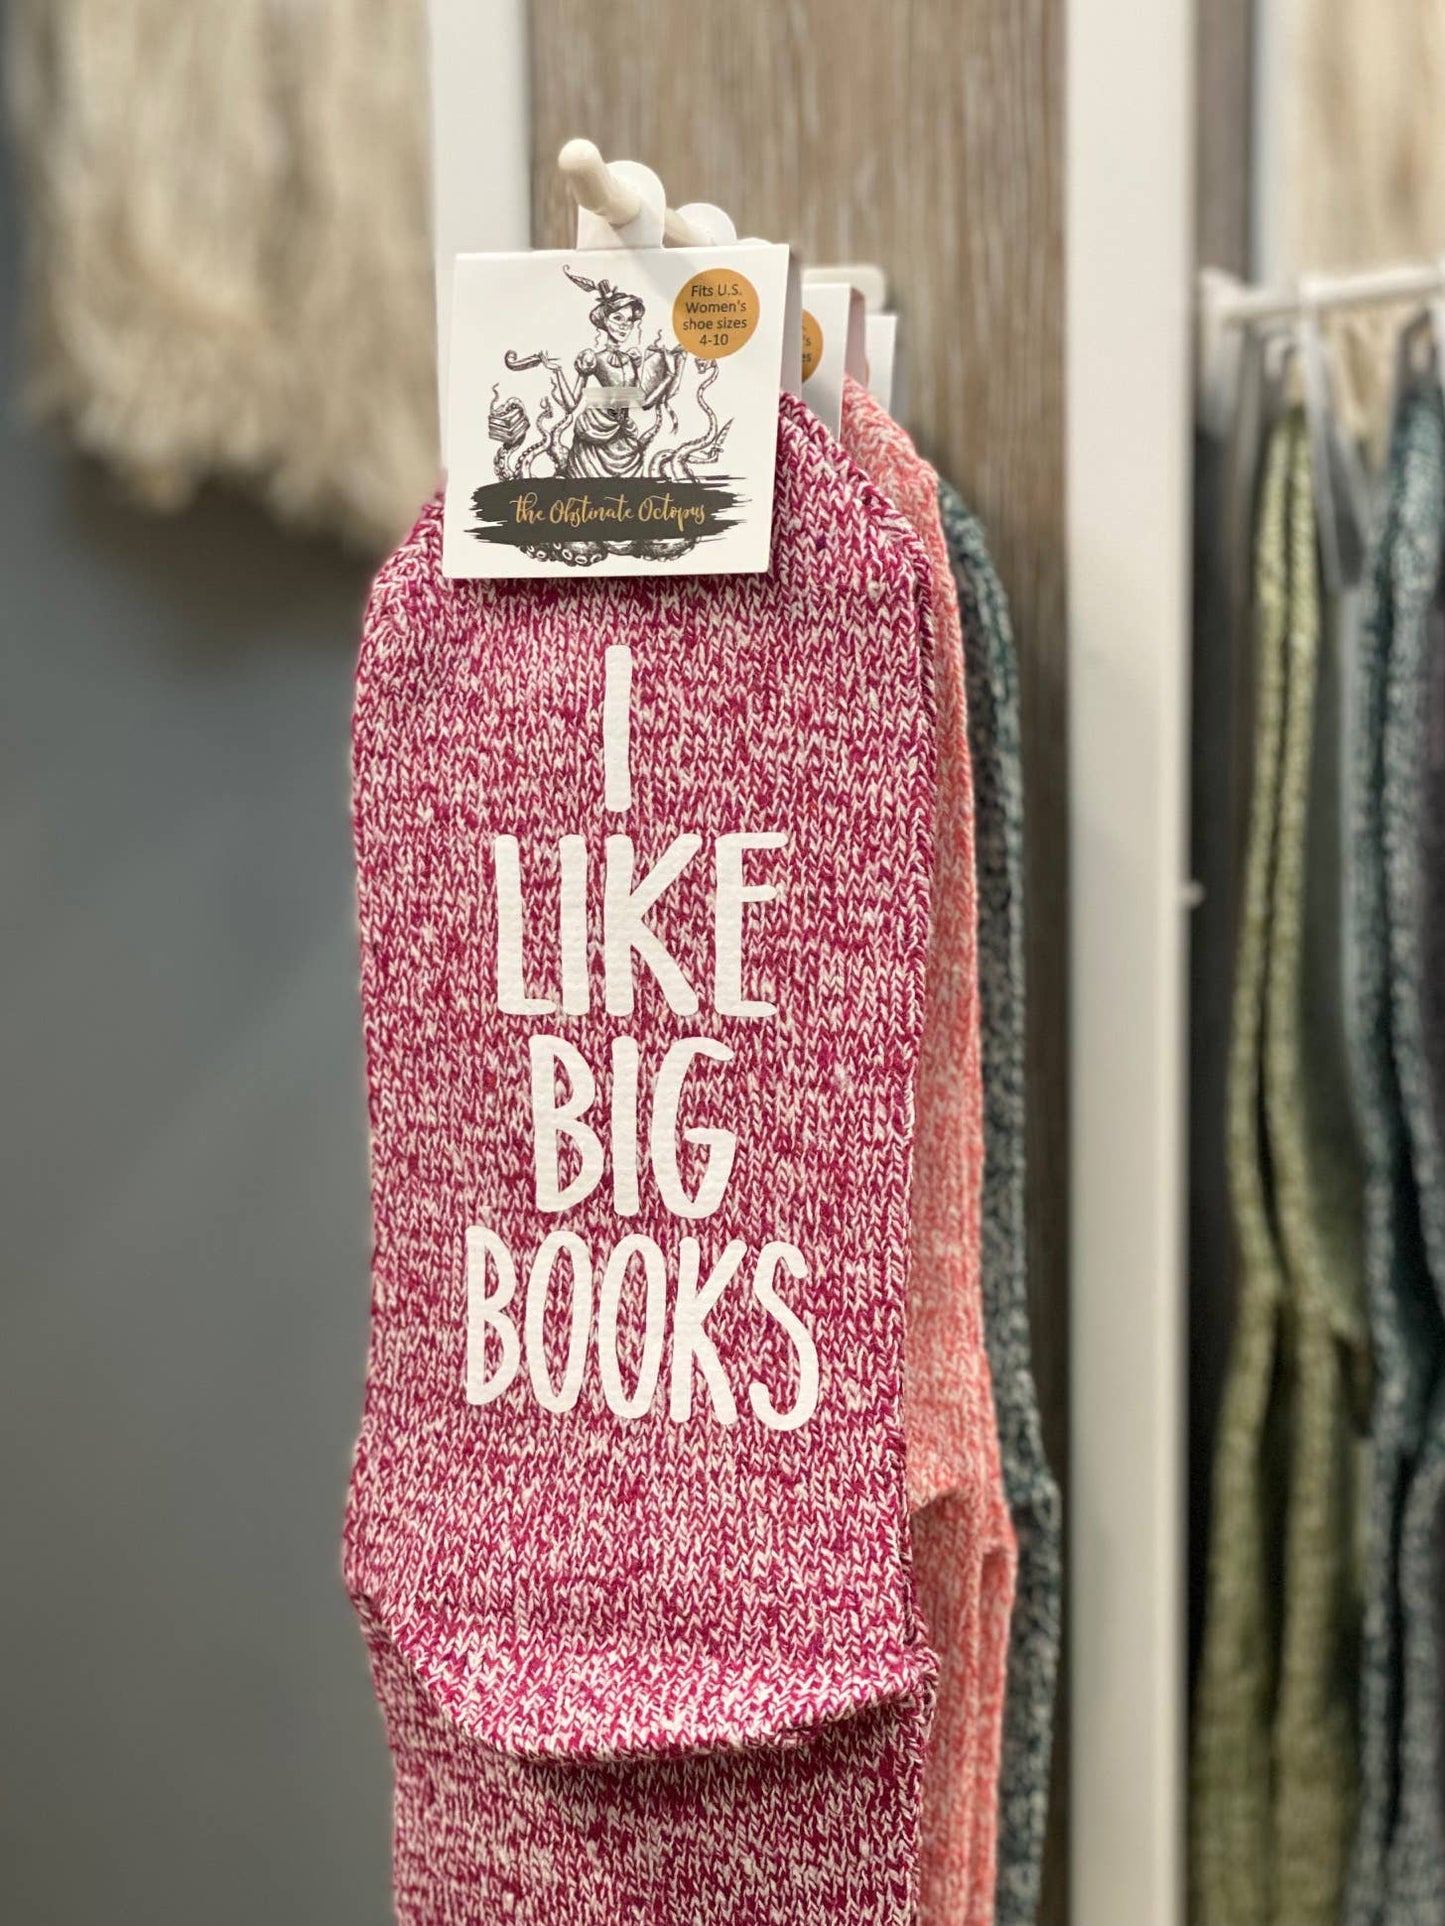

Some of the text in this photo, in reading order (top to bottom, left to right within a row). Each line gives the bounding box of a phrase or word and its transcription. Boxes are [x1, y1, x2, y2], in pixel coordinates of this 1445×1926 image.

[685, 299, 747, 314] Women's
[691, 283, 743, 297] Fits U.S.
[683, 316, 747, 331] shoe sizes
[699, 333, 729, 346] 4-10
[550, 493, 634, 528] Obstinate
[638, 493, 705, 532] Octopus
[603, 644, 632, 812] I
[494, 832, 789, 1017] LIKE
[528, 1034, 737, 1219] BIG
[465, 1225, 820, 1431] BOOKS
